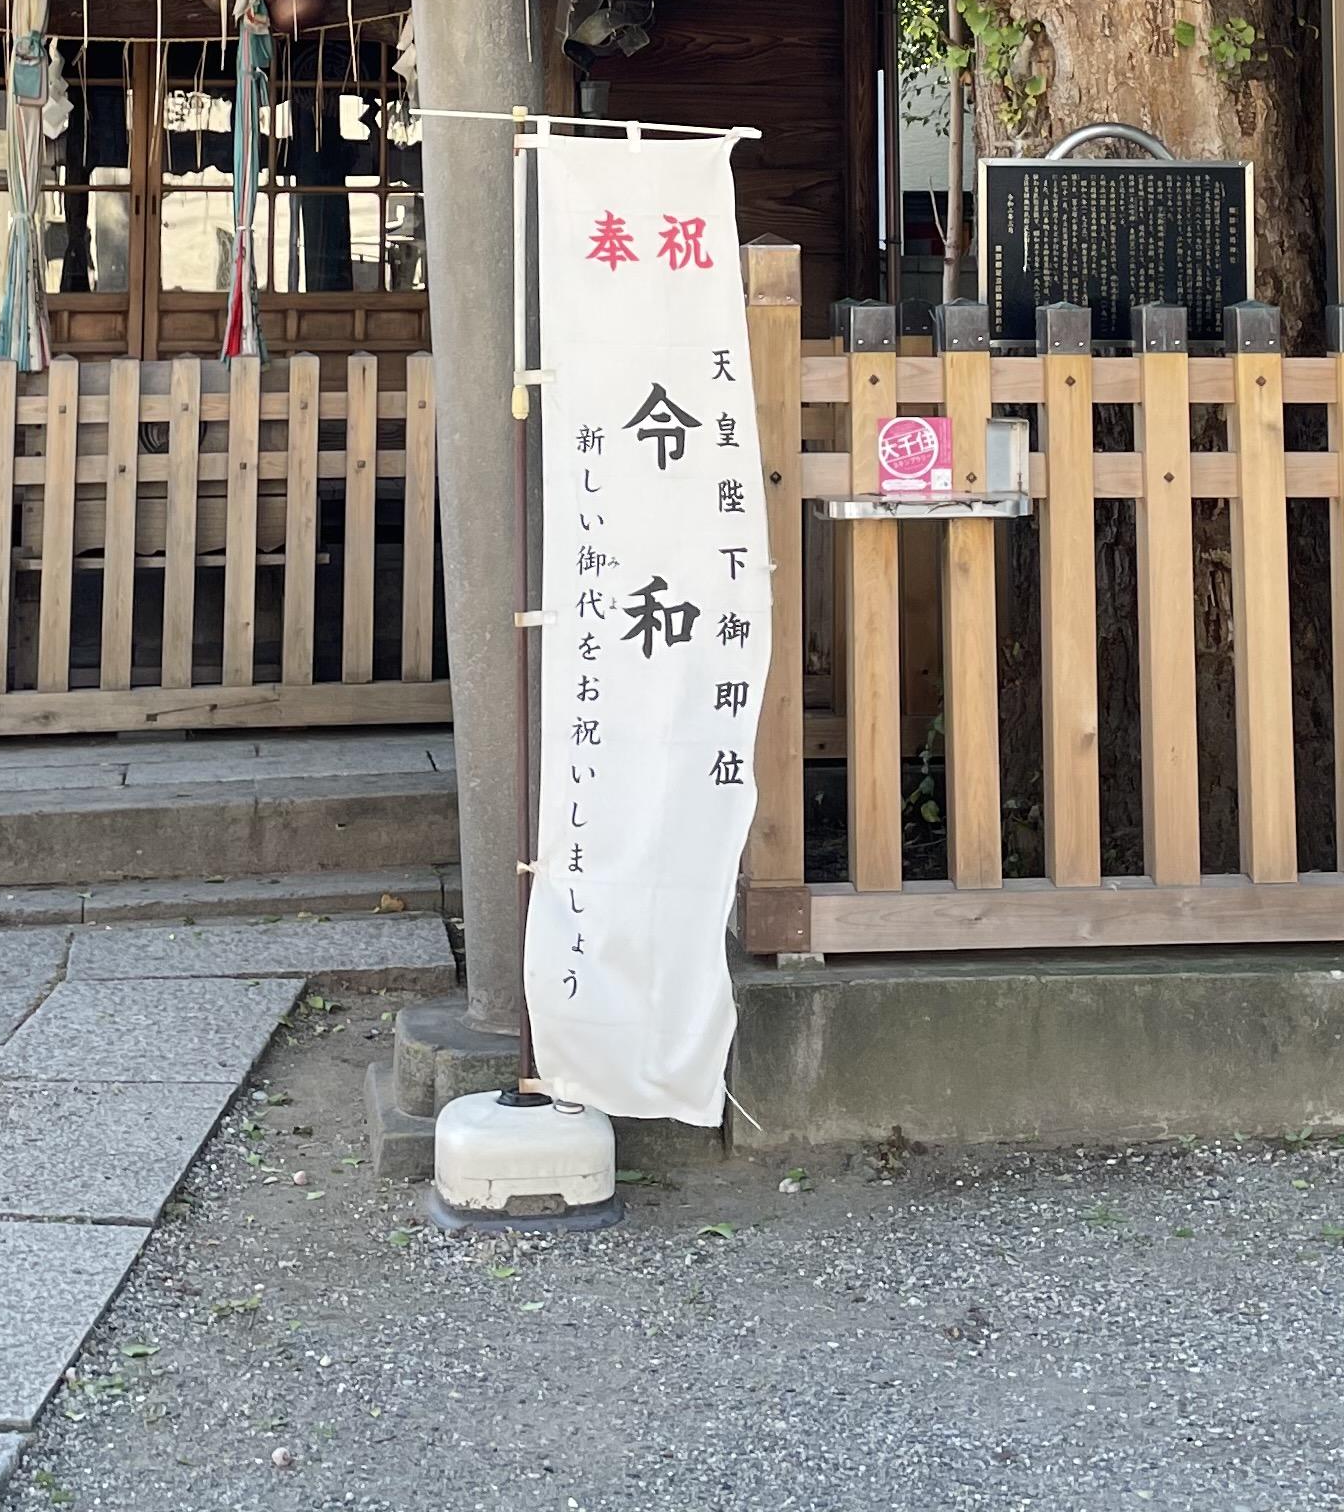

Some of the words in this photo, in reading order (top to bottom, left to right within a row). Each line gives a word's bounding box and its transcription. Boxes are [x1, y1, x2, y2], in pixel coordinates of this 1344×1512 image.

[586, 210, 714, 271] 奉祝
[620, 381, 703, 659] 令和
[711, 348, 751, 786] 天皇陛下御即位
[563, 423, 606, 999] 新しい御代をお祝いしましょう
